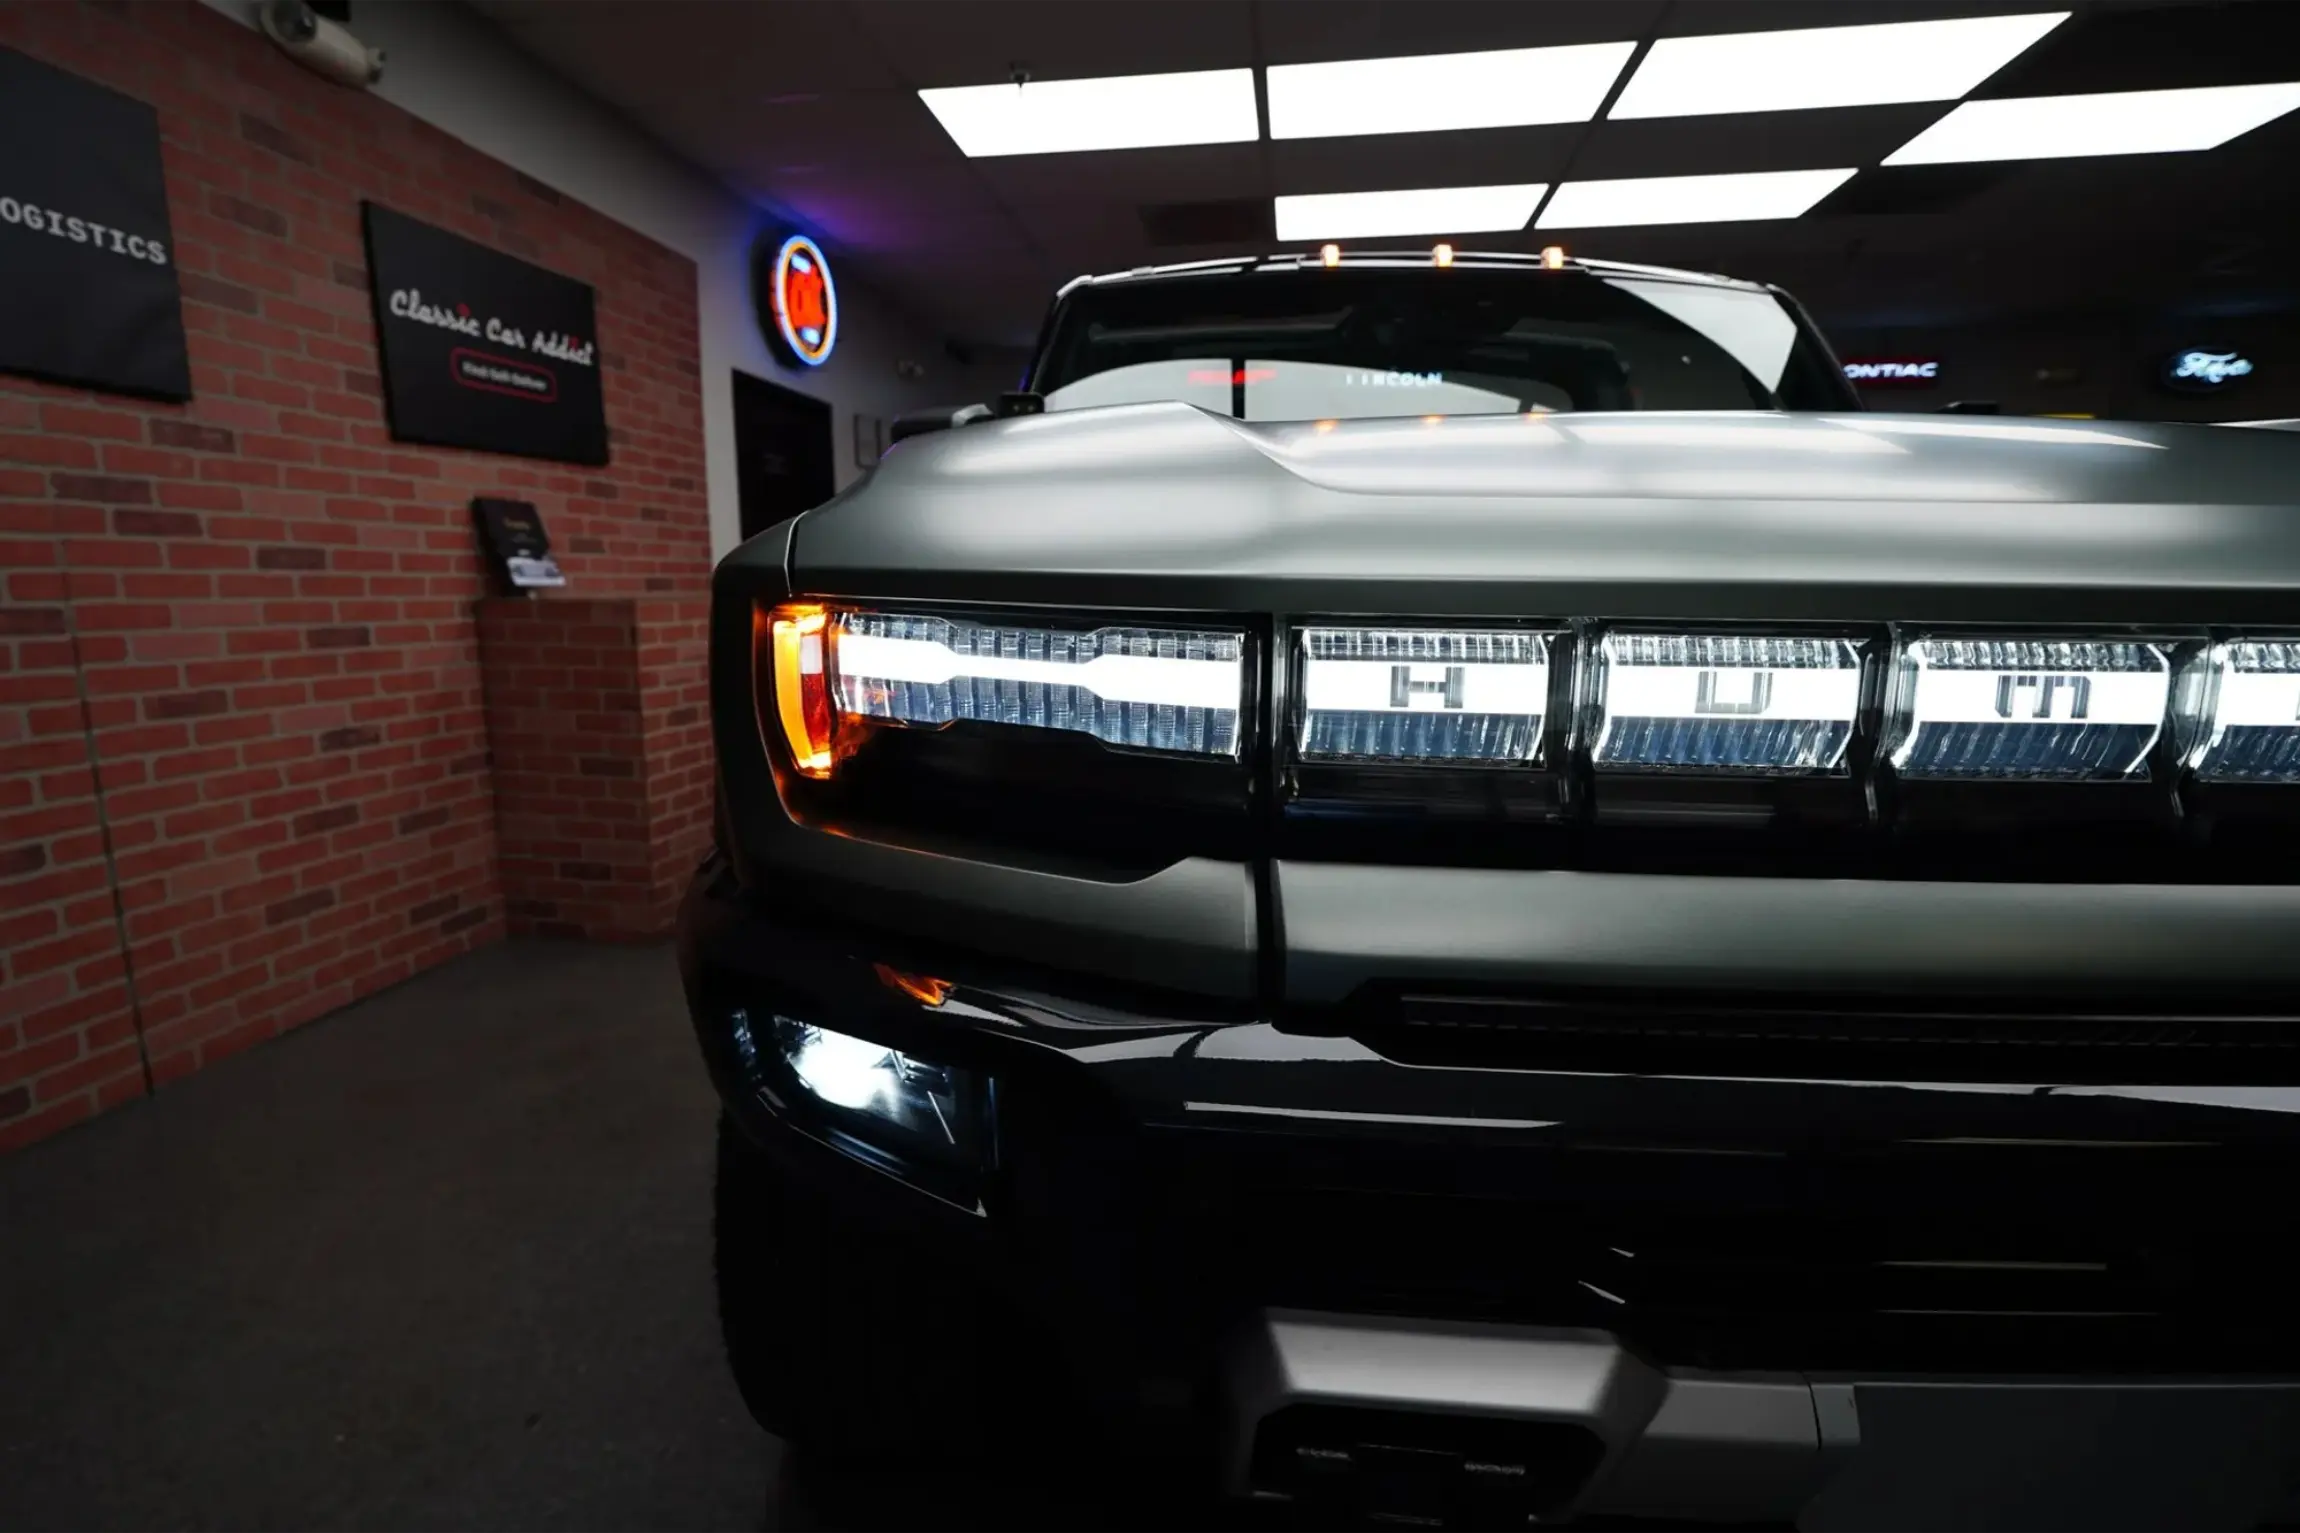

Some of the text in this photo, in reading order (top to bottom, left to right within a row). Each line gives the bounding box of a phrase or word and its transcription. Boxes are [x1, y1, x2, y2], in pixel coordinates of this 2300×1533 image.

[0, 196, 168, 265] OGISTICS
[390, 288, 594, 366] Classic Car Addict
[1843, 362, 1938, 379] ONTIAC
